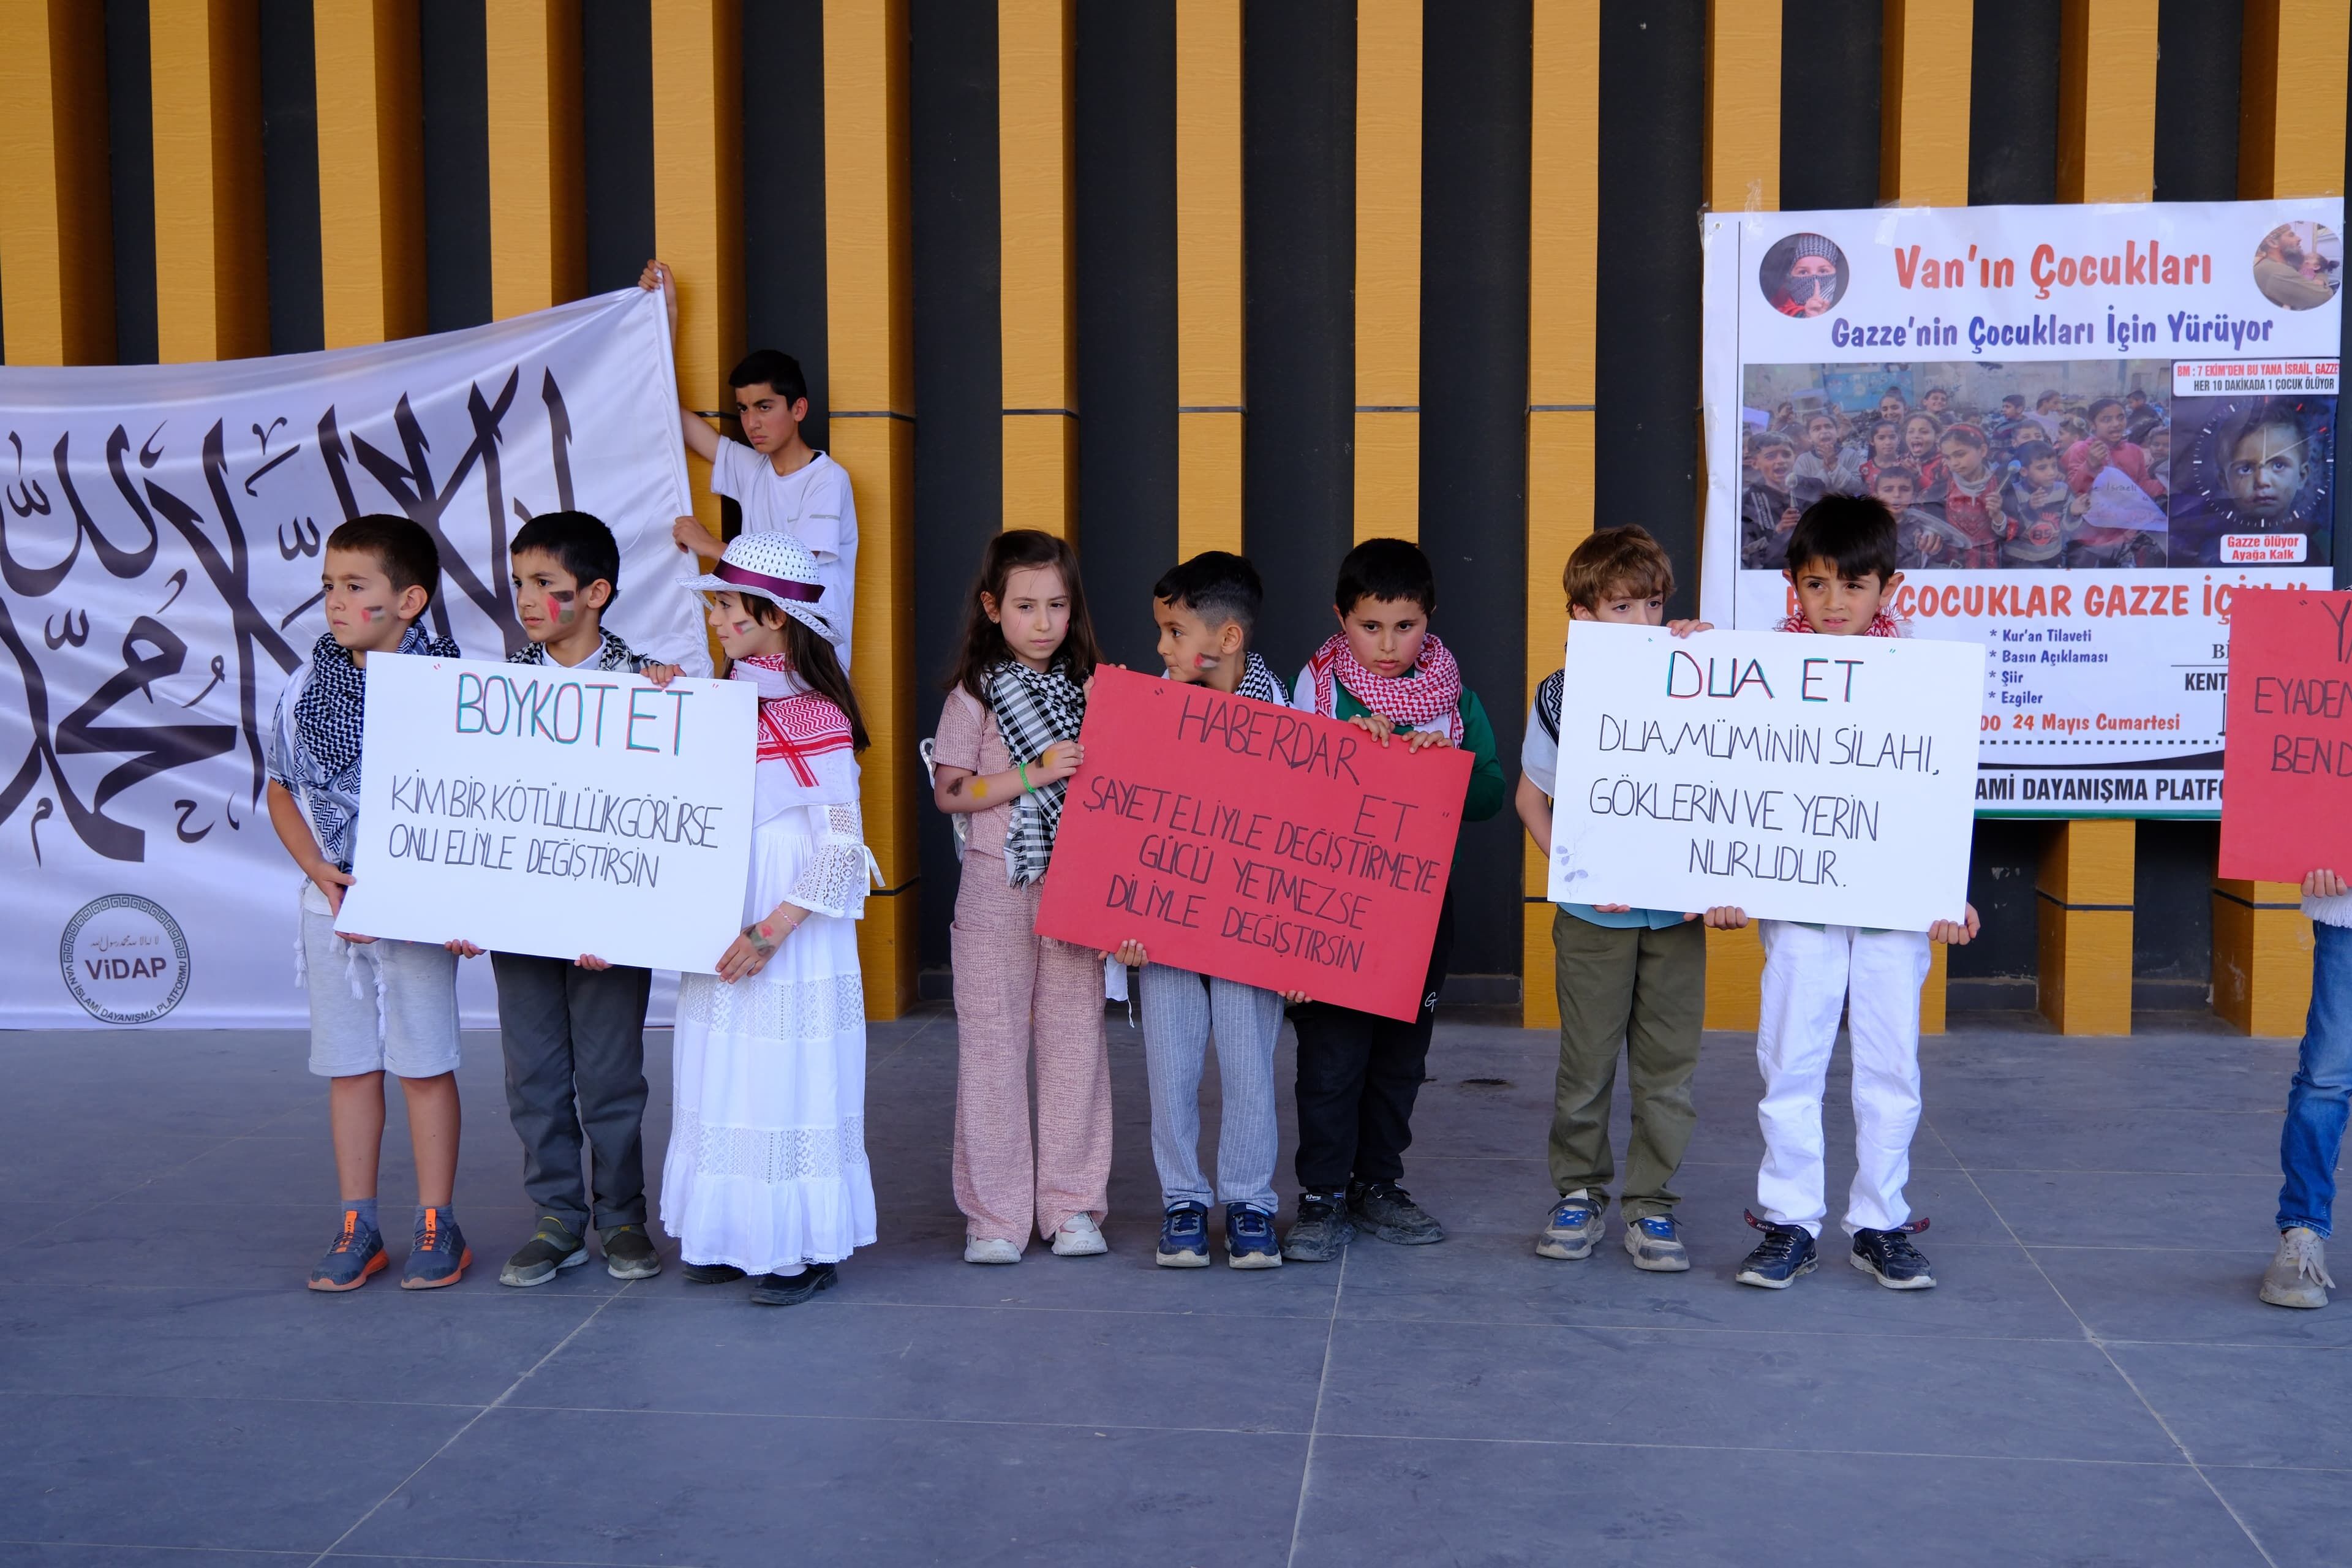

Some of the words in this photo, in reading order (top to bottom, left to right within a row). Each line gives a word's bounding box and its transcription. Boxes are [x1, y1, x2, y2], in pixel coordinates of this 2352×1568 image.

[1894, 244, 2014, 289] Van'ın
[2030, 240, 2211, 300] Çocukları
[1831, 316, 1957, 347] Gazze'nin
[1969, 314, 2094, 354] Çocukları
[2108, 304, 2156, 352] İçin
[2168, 311, 2273, 351] Yürüyor
[2177, 366, 2190, 377] BM
[2198, 366, 2202, 376] 7
[2206, 363, 2244, 376] EKİM'DEN
[2247, 365, 2258, 375] BU
[2261, 364, 2282, 375] YANA
[2194, 380, 2210, 391] HER
[2213, 380, 2222, 391] 10
[2225, 378, 2265, 390] DAKİKADA
[2275, 379, 2302, 391] ÇOCUK
[2305, 376, 2334, 390] ÖLÜYOR
[2228, 536, 2260, 548] Gazze
[2264, 535, 2299, 548] ölüyor
[2232, 550, 2266, 561] Ayağa
[2270, 549, 2294, 559] Kalk
[1898, 584, 2071, 622] ÇOCUKLAR
[2084, 585, 2188, 618] GAZZE
[2203, 575, 2271, 625] İÇ
[2002, 650, 2036, 663] Basın
[2041, 649, 2108, 666] Açıklaması
[2003, 629, 2042, 642] Kur'an
[2047, 628, 2092, 642] Tilaveti
[1667, 650, 1774, 699] DUA
[1801, 658, 1864, 703] ET
[2001, 671, 2023, 687] Şiir
[2001, 691, 2043, 707] Ezgiler
[2185, 673, 2228, 691] KENT
[456, 672, 618, 747] BOYKOT
[626, 687, 693, 756] ET
[2013, 714, 2034, 730] 24
[2042, 713, 2089, 735] Mayıs
[2096, 714, 2180, 731] Cumartesi
[1178, 695, 1360, 785] HABERDAR
[1830, 723, 1940, 775] SİLAHI,
[1590, 774, 1737, 824] GÖKLERİN
[1744, 790, 1783, 831] VE
[1794, 794, 1879, 841] YERİN
[2023, 778, 2148, 804] DAYANIŞMA
[2156, 778, 2225, 801] PLATF
[1354, 794, 1418, 842] ET
[390, 824, 438, 861] ONU
[445, 827, 516, 870] ELİYLE
[1106, 874, 1206, 929] DİLİYLE
[1139, 834, 1213, 884] GÜCÜ
[1232, 858, 1373, 930] YETMEZSE
[66, 965, 78, 986] VAN
[74, 984, 102, 1013] İSLAMİ
[100, 1009, 157, 1023] DAYANIŞMA
[157, 960, 187, 1013] PLATFORMU
